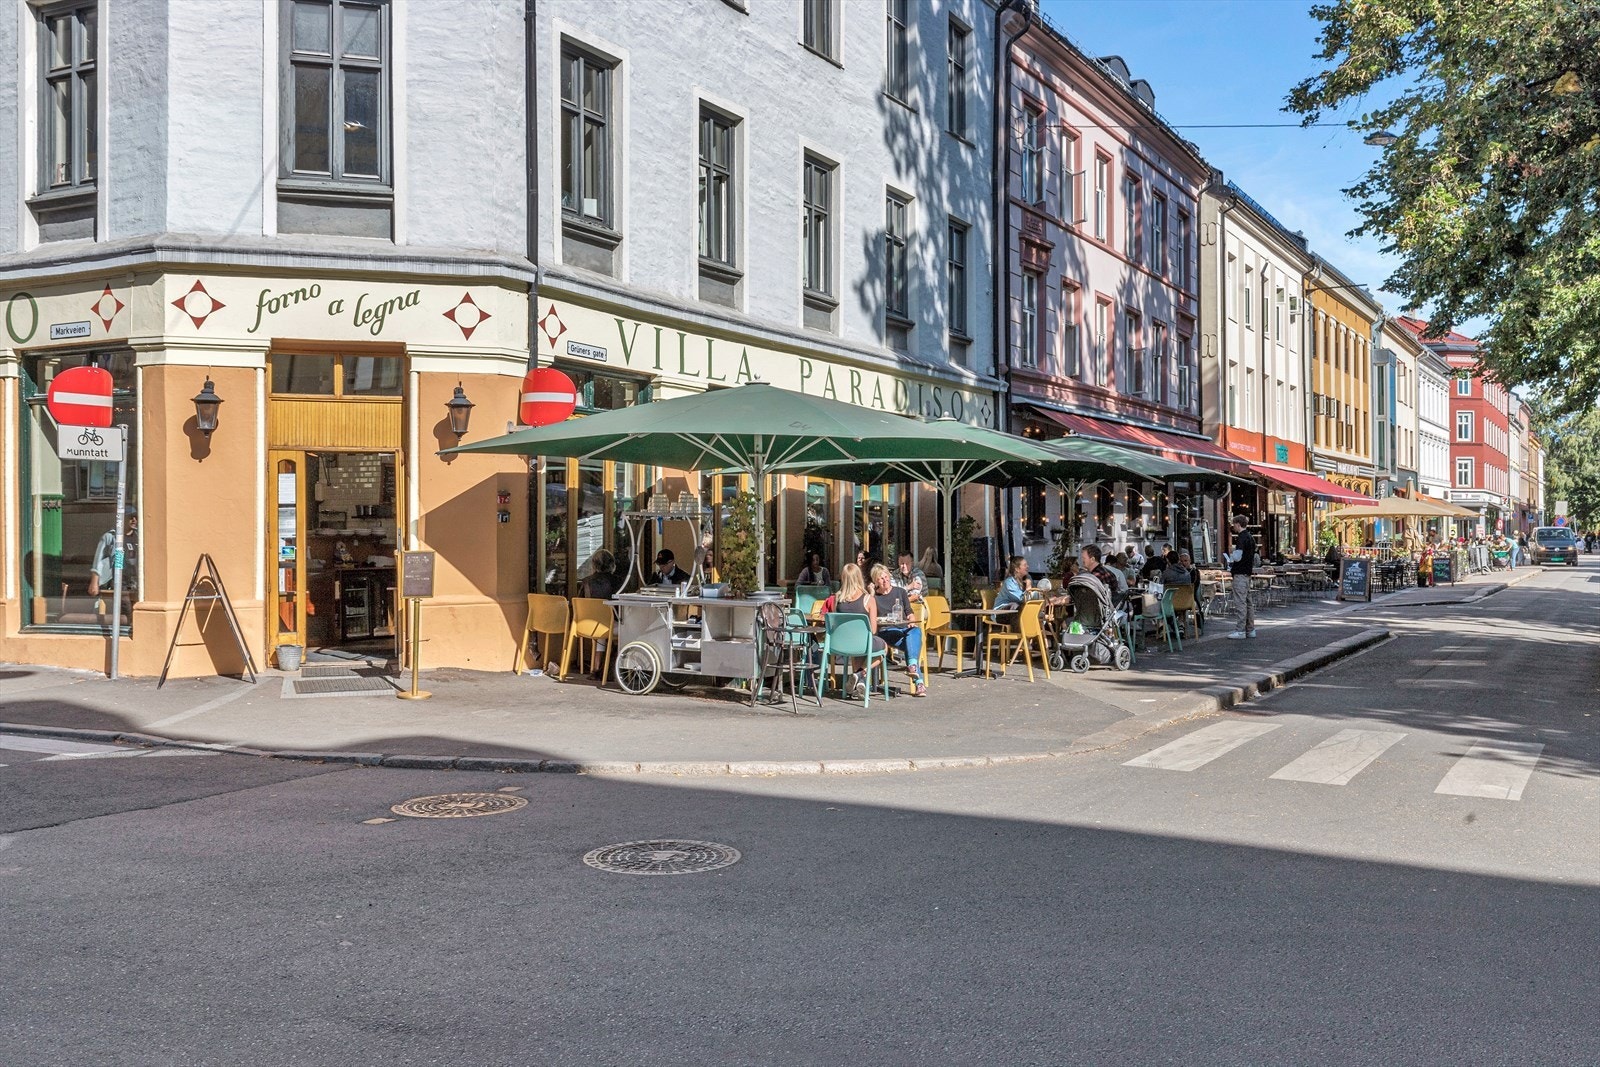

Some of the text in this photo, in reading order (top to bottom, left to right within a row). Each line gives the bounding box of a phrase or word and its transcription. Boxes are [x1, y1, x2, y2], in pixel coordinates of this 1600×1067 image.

[247, 283, 421, 336] forno a legna
[55, 325, 86, 336] Markveien
[570, 344, 604, 359] Grüners gate
[614, 317, 964, 422] VILLA PARADISO
[66, 447, 109, 458] Munntatt
